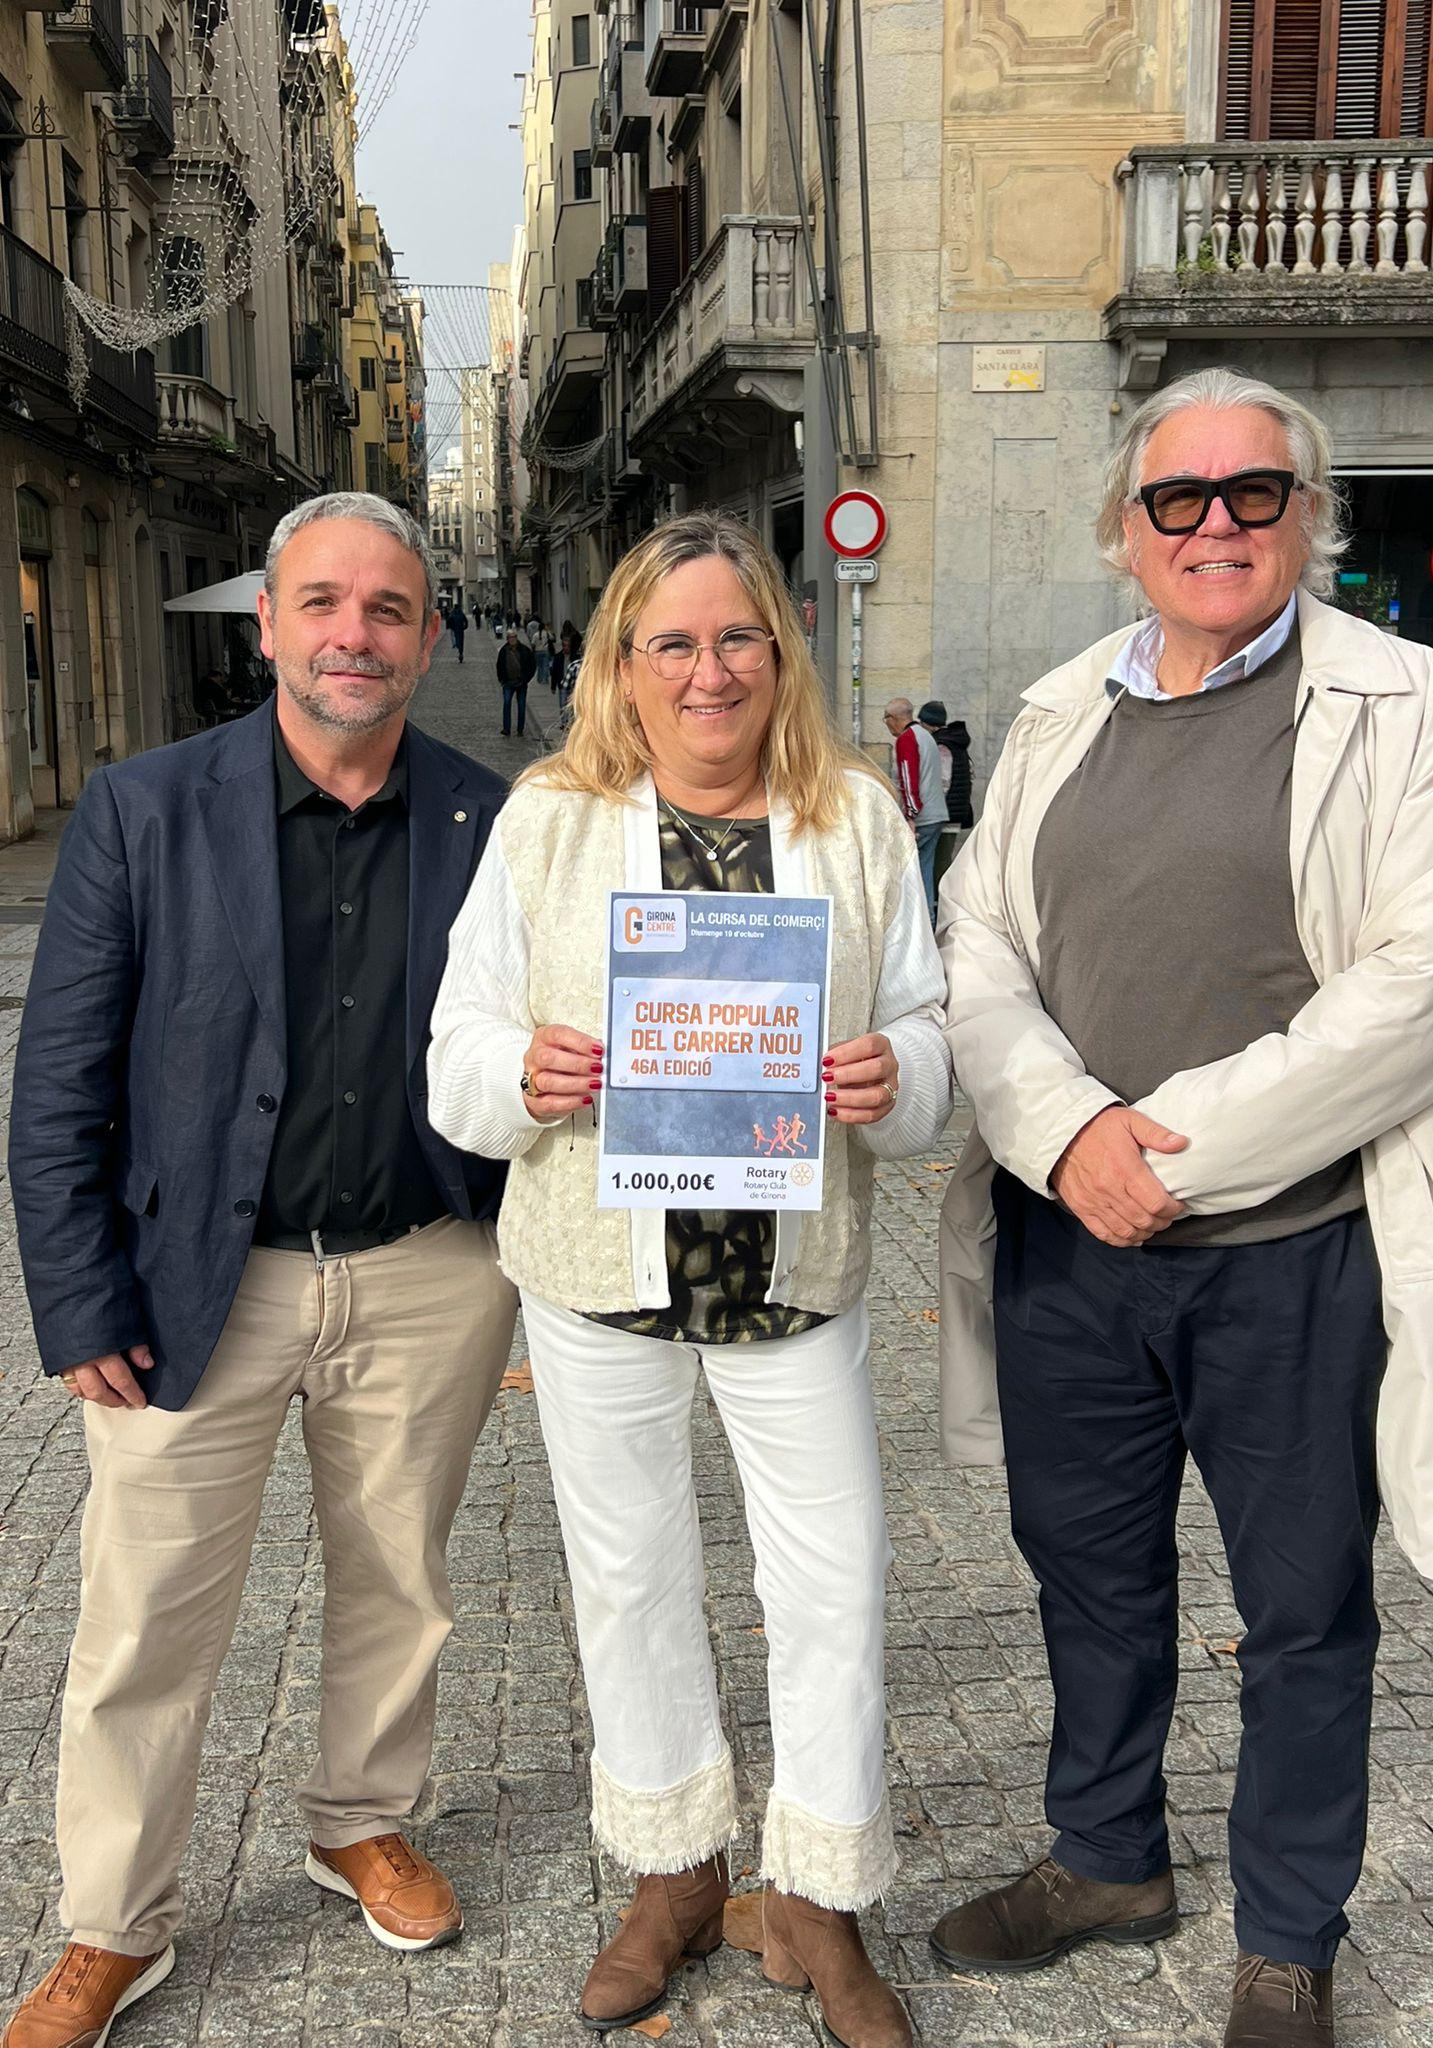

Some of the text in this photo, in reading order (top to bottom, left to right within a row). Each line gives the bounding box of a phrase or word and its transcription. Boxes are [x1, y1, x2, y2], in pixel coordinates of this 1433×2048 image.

[976, 362, 1040, 371] SANTA CLARA
[646, 911, 676, 922] GIRONA
[690, 911, 826, 931] LA CURSA DEL COMERÇ!
[646, 922, 676, 932] CENTRE
[690, 928, 723, 938] Diumenge
[635, 1001, 799, 1028] CURSA POPULAR
[631, 1029, 802, 1055] DEL CARRER NOU
[630, 1057, 801, 1079] 46A EDICIÓ 2025
[746, 1166, 787, 1181] Rotary
[611, 1172, 715, 1194] 1.000,00€
[743, 1181, 787, 1191] Rotary Club
[760, 1192, 786, 1200] Girona
